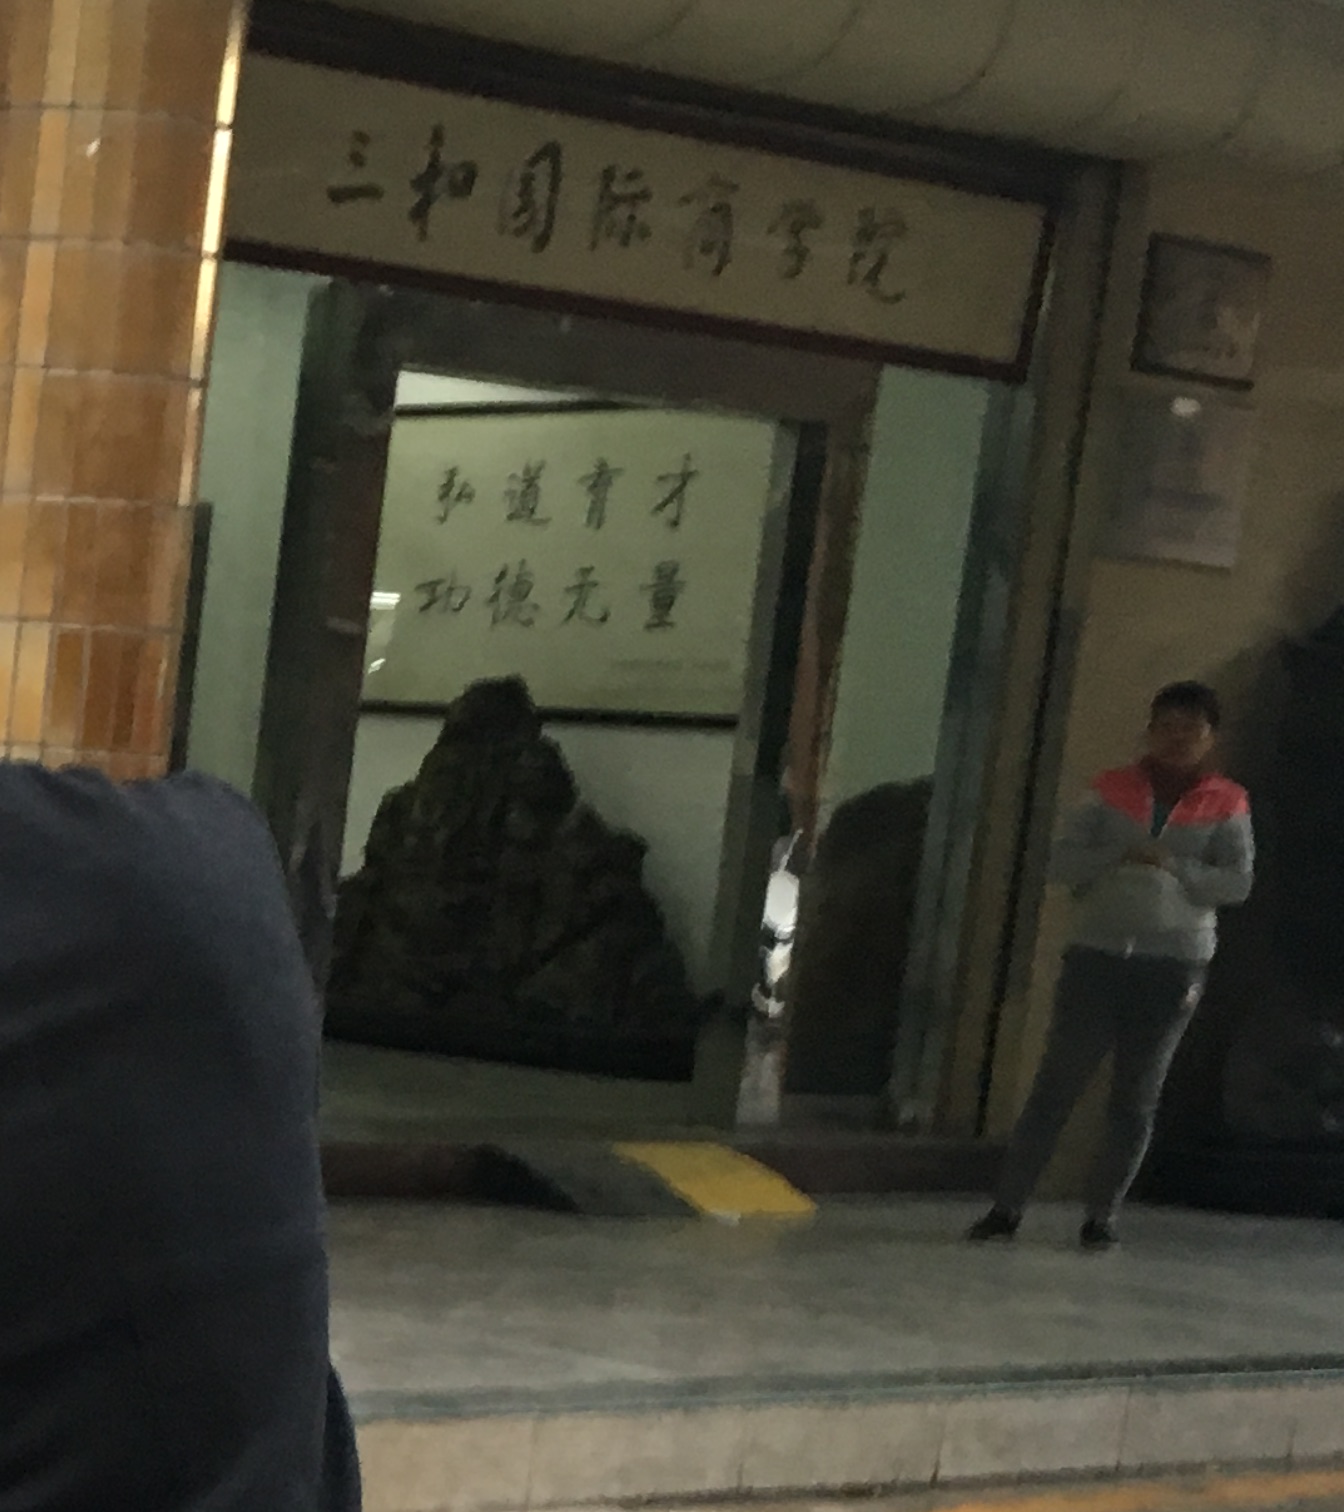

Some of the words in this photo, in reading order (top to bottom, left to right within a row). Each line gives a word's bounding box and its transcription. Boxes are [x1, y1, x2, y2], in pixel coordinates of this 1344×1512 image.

[434, 452, 700, 532] 弘道育才
[414, 557, 687, 631] 功德无量
